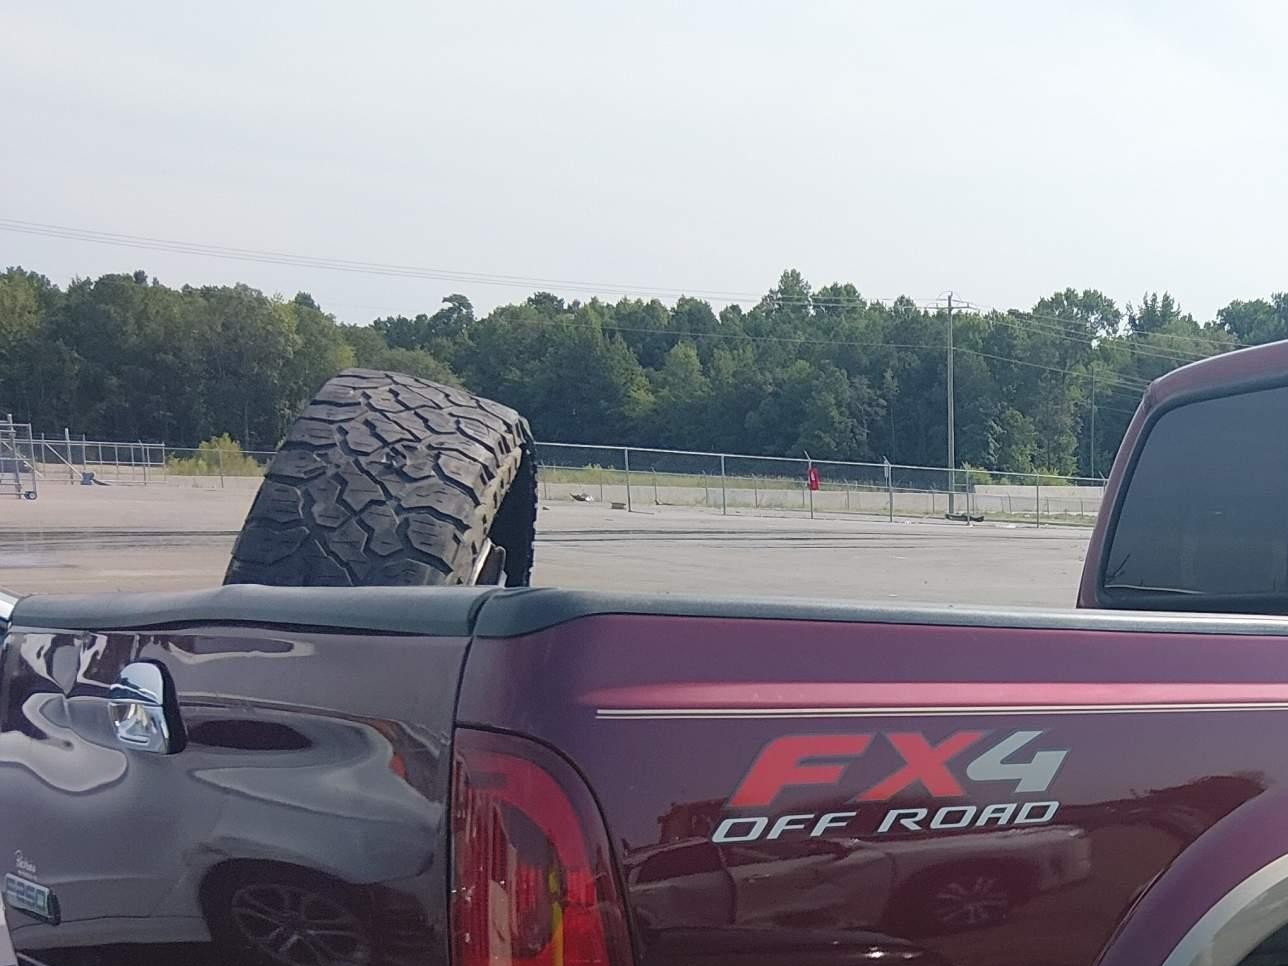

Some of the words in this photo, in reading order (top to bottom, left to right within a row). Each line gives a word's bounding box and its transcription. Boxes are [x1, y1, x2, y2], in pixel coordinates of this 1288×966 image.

[728, 730, 1069, 808] FX4
[711, 811, 857, 843] OFF
[876, 801, 1060, 833] ROAD
